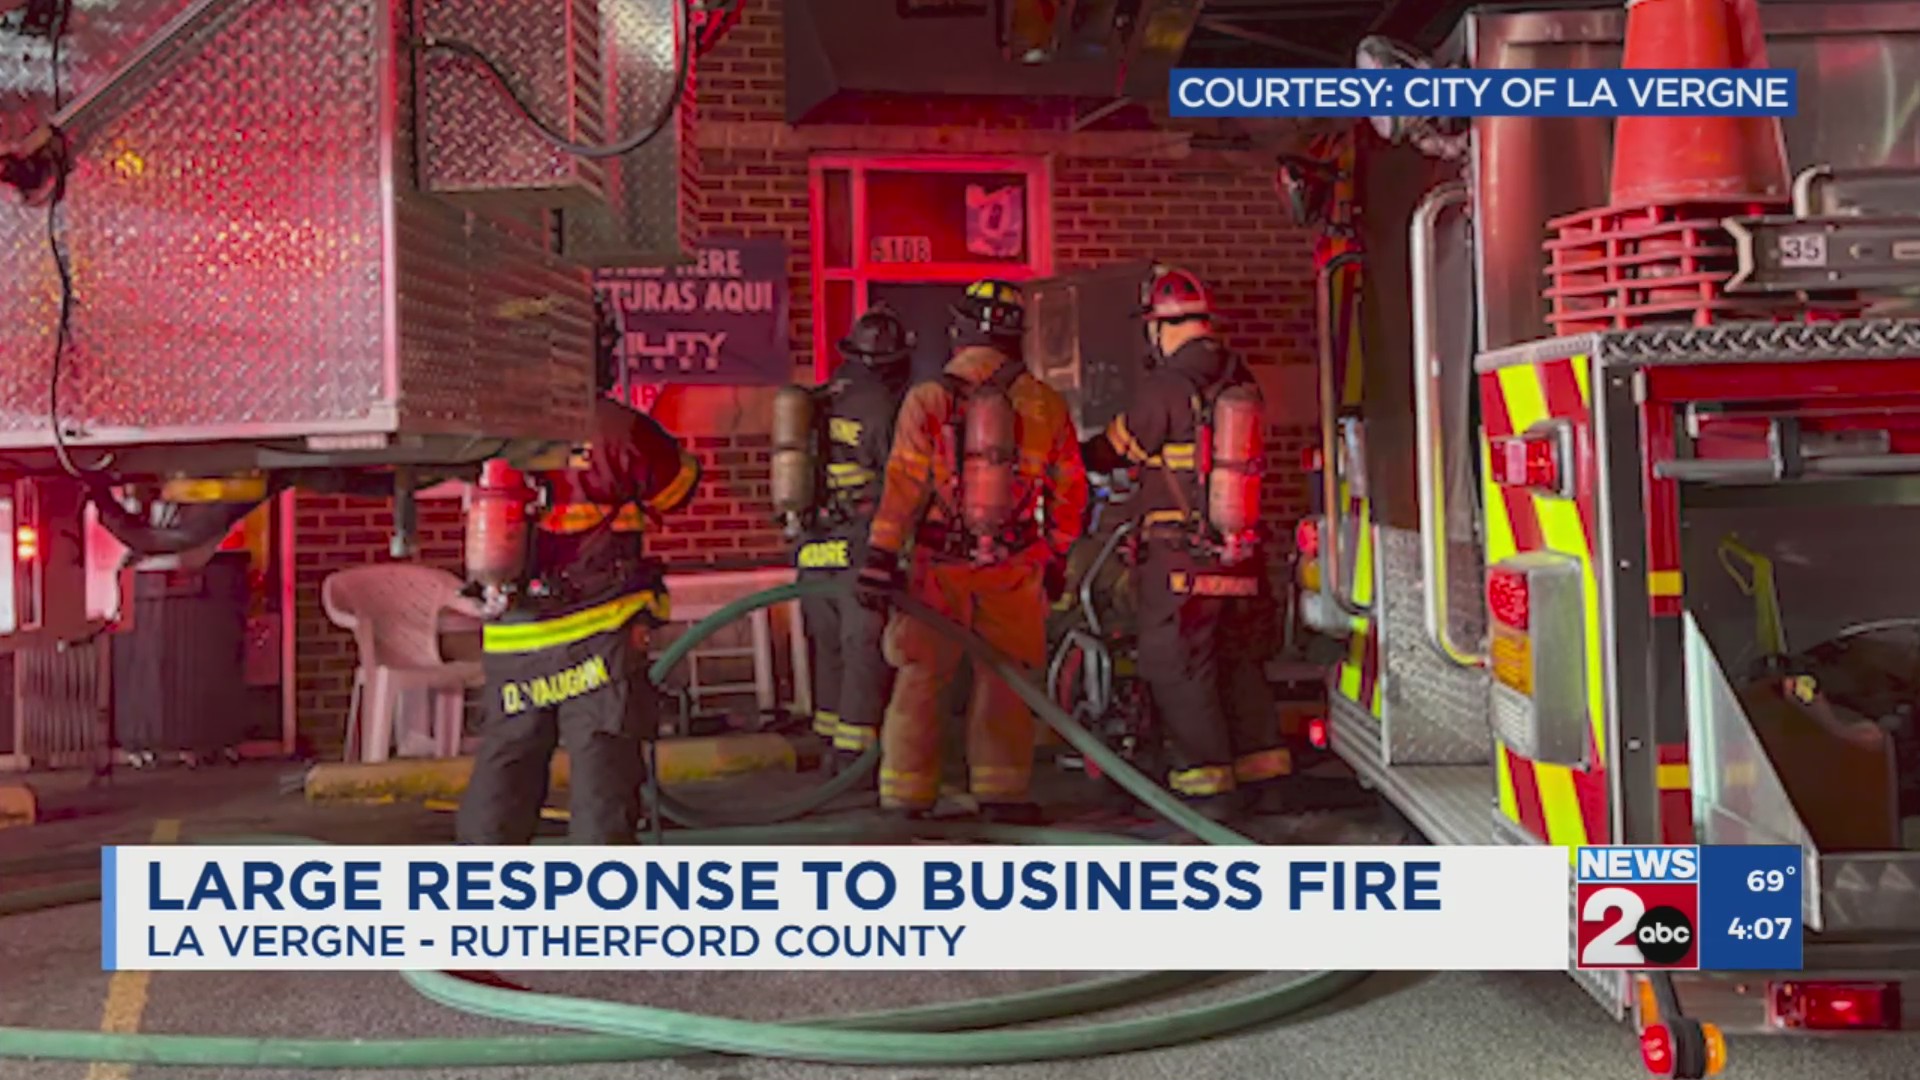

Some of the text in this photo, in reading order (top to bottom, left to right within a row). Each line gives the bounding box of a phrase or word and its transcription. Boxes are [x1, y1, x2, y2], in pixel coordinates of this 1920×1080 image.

[677, 250, 742, 276] ERE
[1785, 238, 1820, 260] 35
[704, 282, 773, 312] AQUI
[521, 655, 609, 709] VAUGHN
